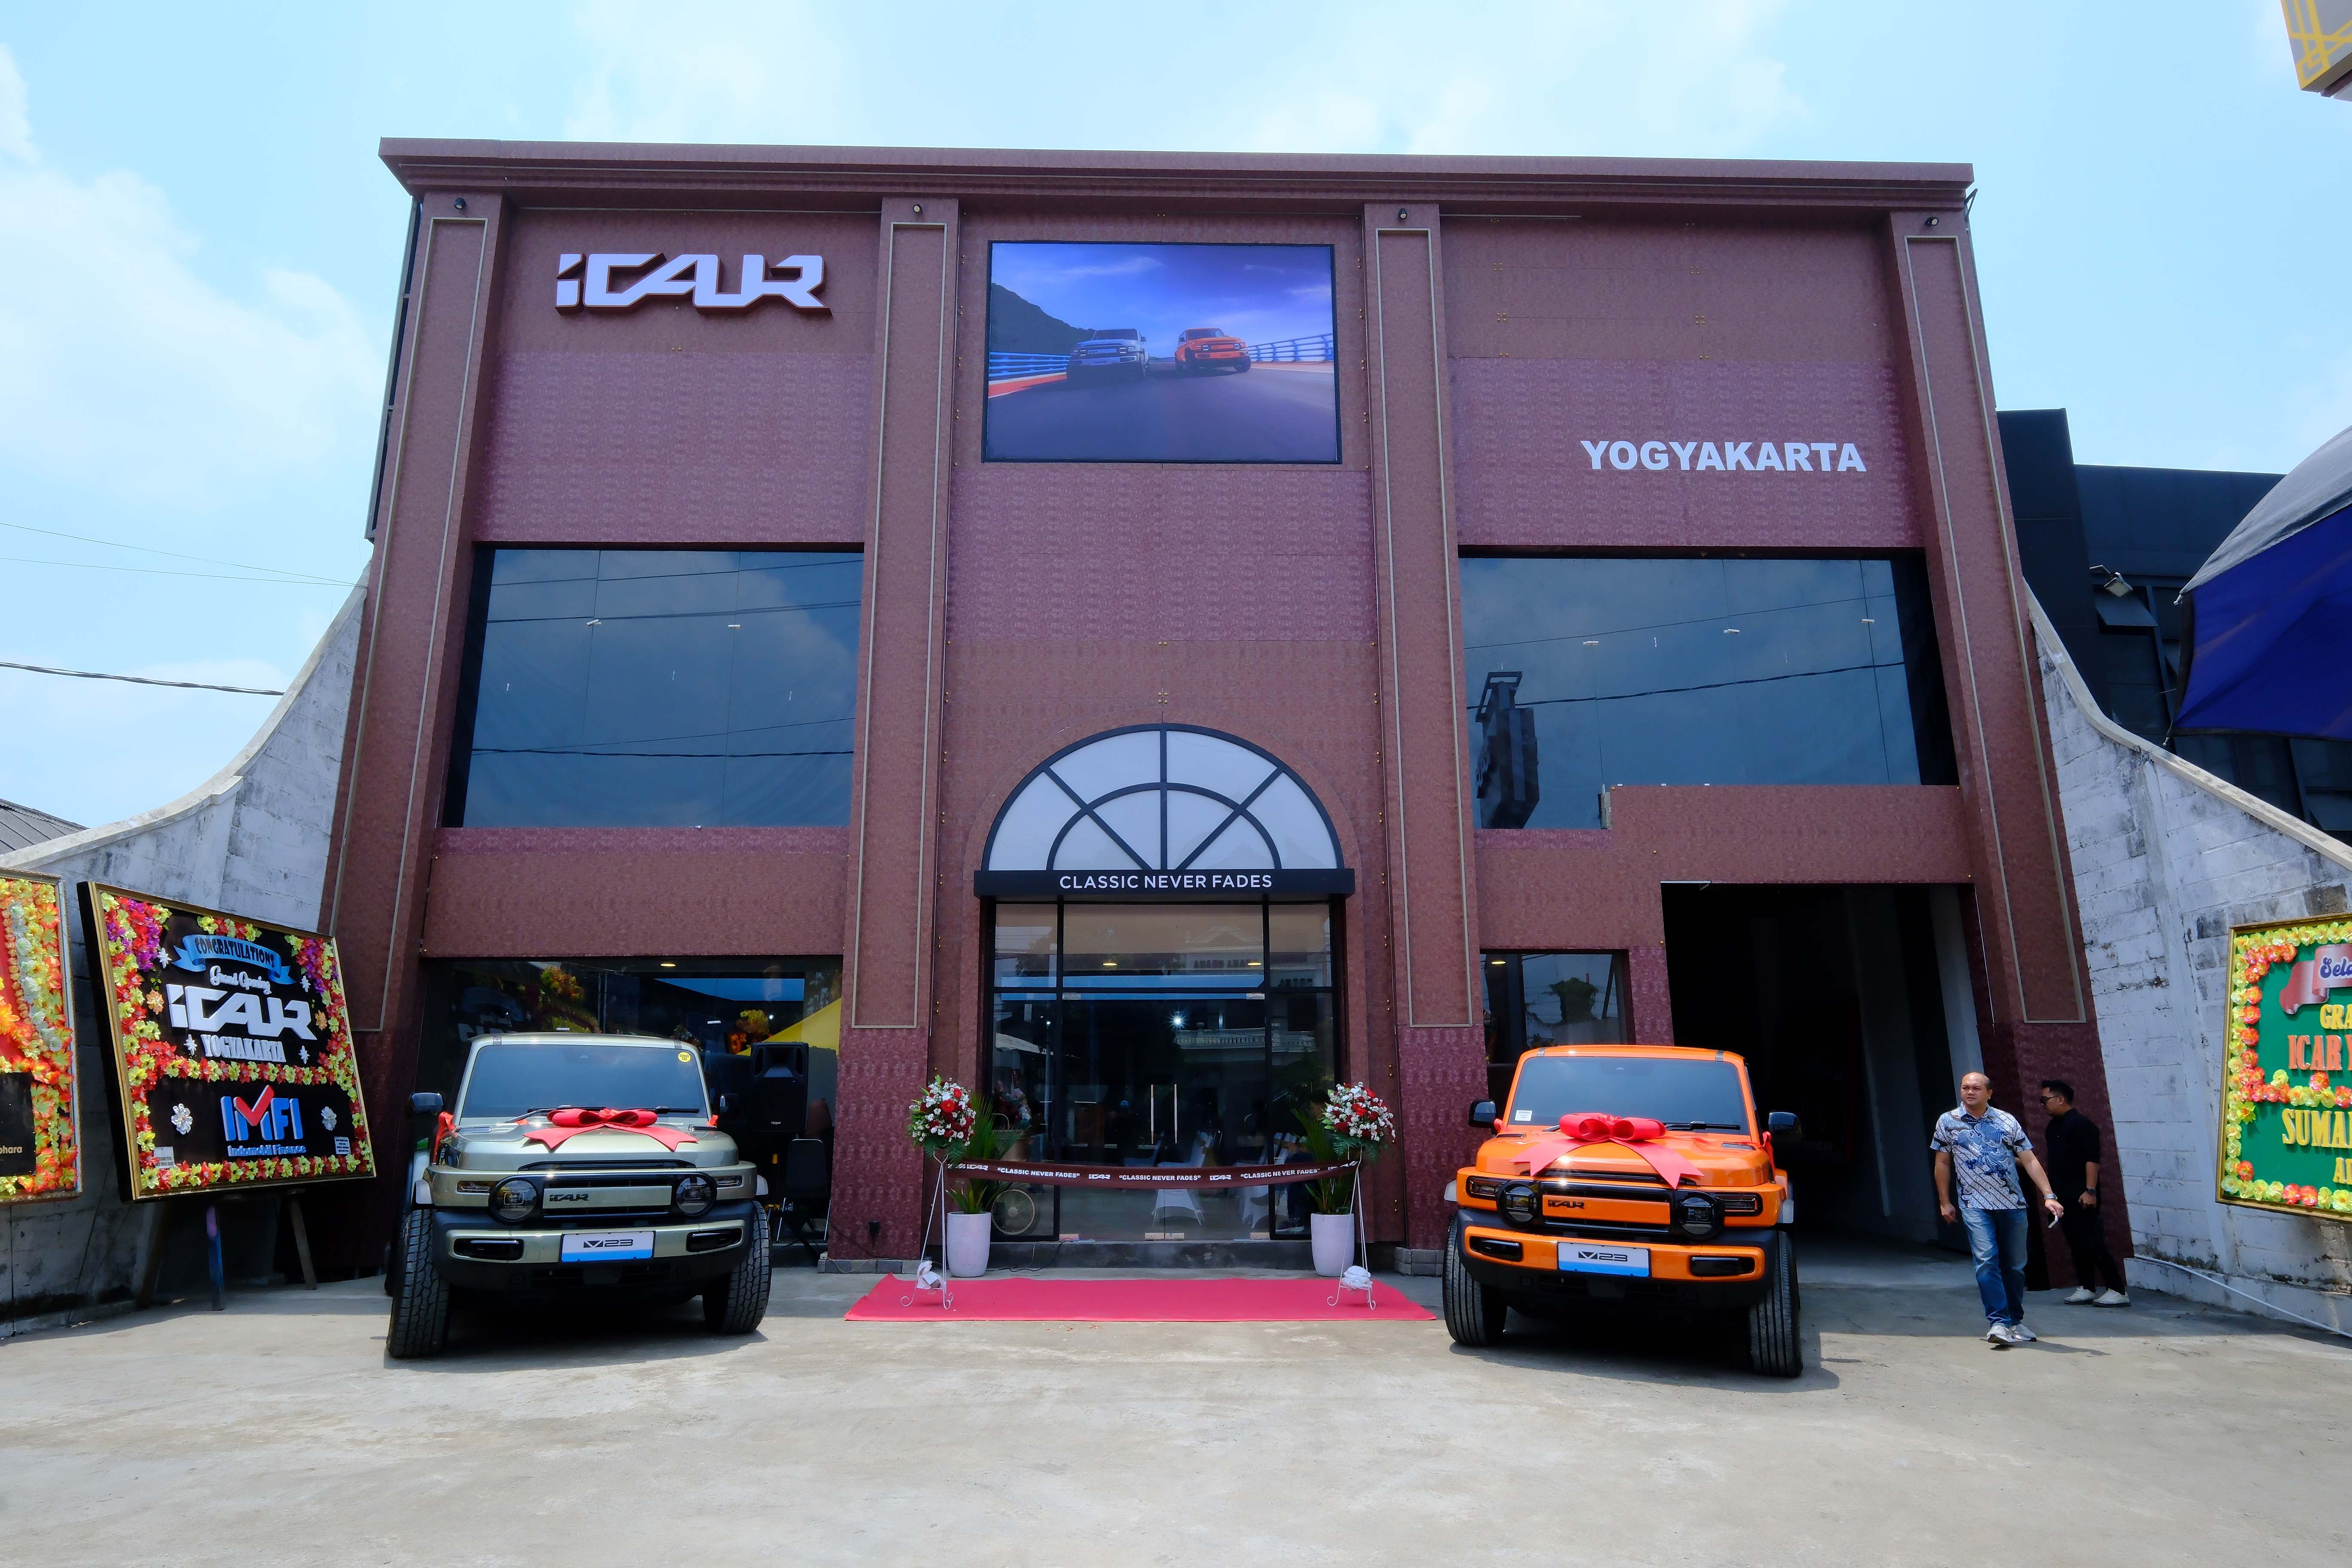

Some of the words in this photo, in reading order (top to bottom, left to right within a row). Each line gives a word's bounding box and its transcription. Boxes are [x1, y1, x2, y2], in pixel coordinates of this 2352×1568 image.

[1580, 441, 1867, 472] YOGYAKARTA
[1059, 875, 1139, 889] CLASSIC
[1144, 875, 1206, 888] NEVER
[1212, 874, 1272, 888] FADES
[194, 937, 275, 968] CONGRATULATIONS
[210, 965, 239, 986] Grand
[239, 971, 272, 995] Opening
[200, 1034, 287, 1063] YOGYAKARTA
[2288, 1035, 2343, 1071] ICAR
[220, 1084, 303, 1141] IMFI
[227, 1145, 273, 1157] Indomobil
[273, 1144, 306, 1155] Finance
[997, 1167, 1029, 1175] “CLASSIC
[583, 1239, 634, 1248] V23
[1578, 1251, 1628, 1262] V23
